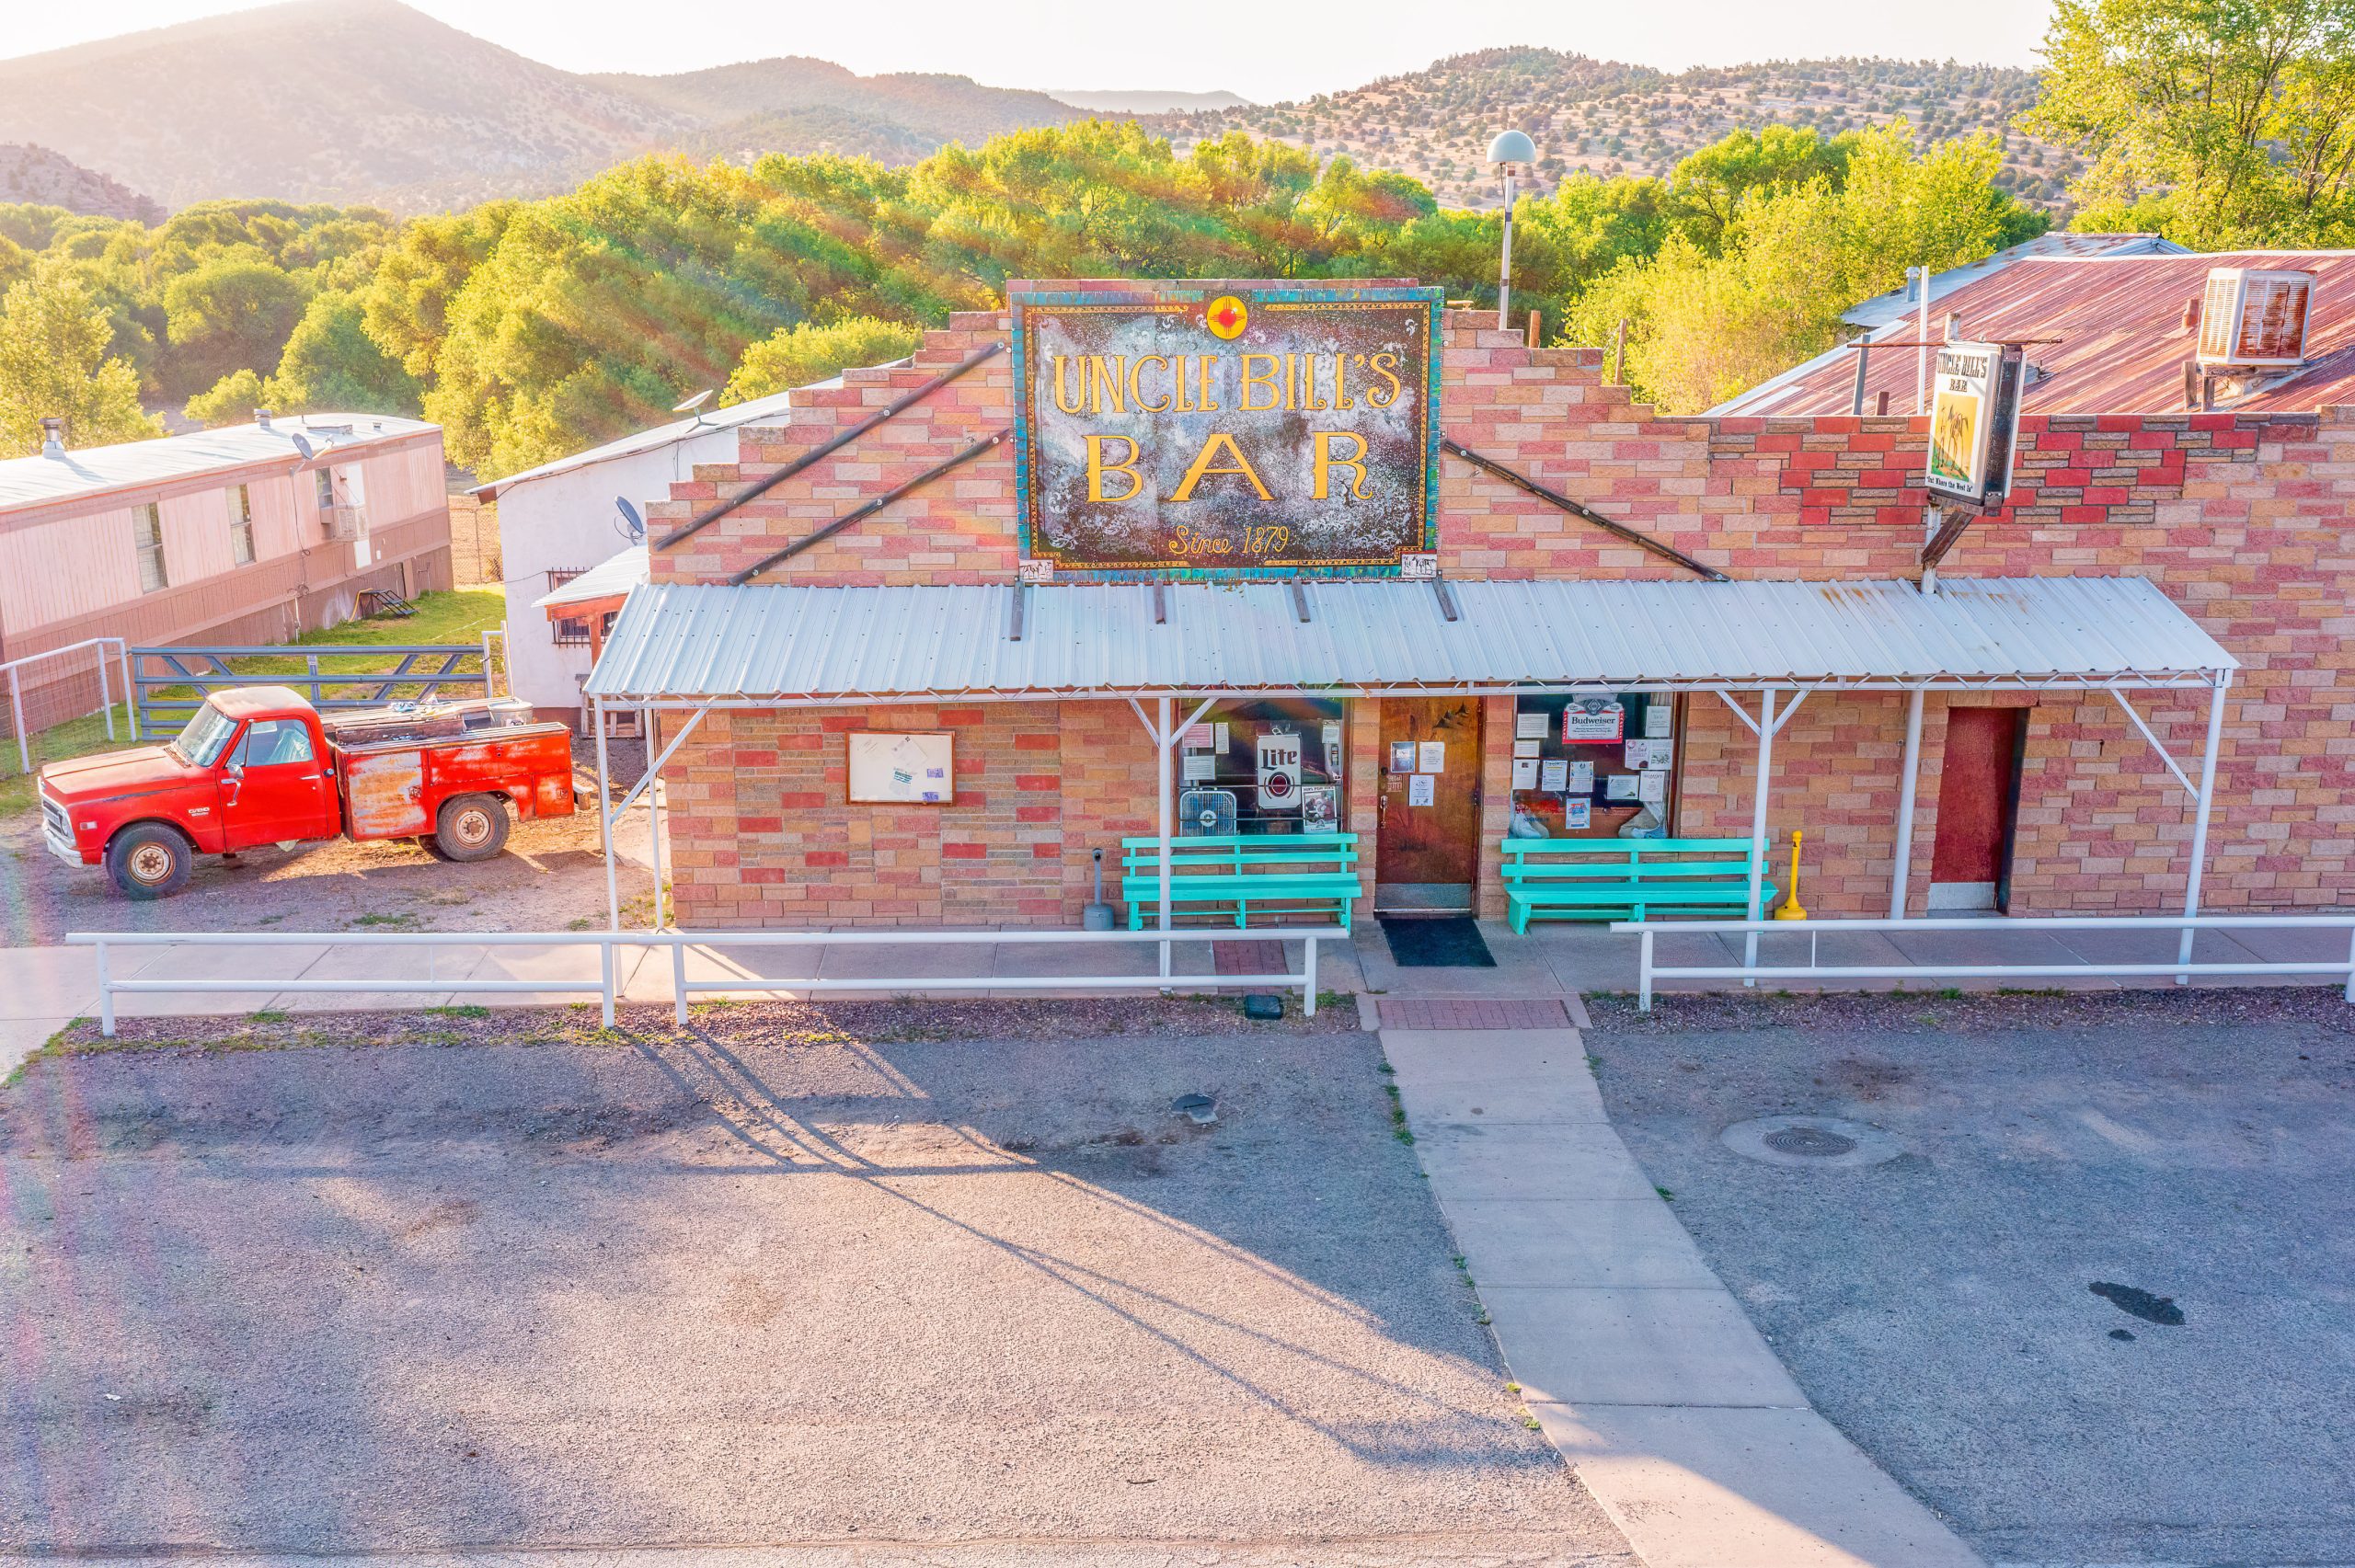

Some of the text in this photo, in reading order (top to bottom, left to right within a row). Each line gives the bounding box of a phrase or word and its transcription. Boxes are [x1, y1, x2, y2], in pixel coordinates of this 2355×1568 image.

[1936, 353, 1988, 378] UNCLE BILL'S
[1051, 352, 1402, 413] UNCLE BILL'S
[1949, 378, 1968, 392] BAR
[1082, 431, 1373, 504] BAR
[1168, 525, 1288, 554] Since 1879
[1571, 716, 1615, 725] Budweiser
[1260, 749, 1297, 771] Lite
